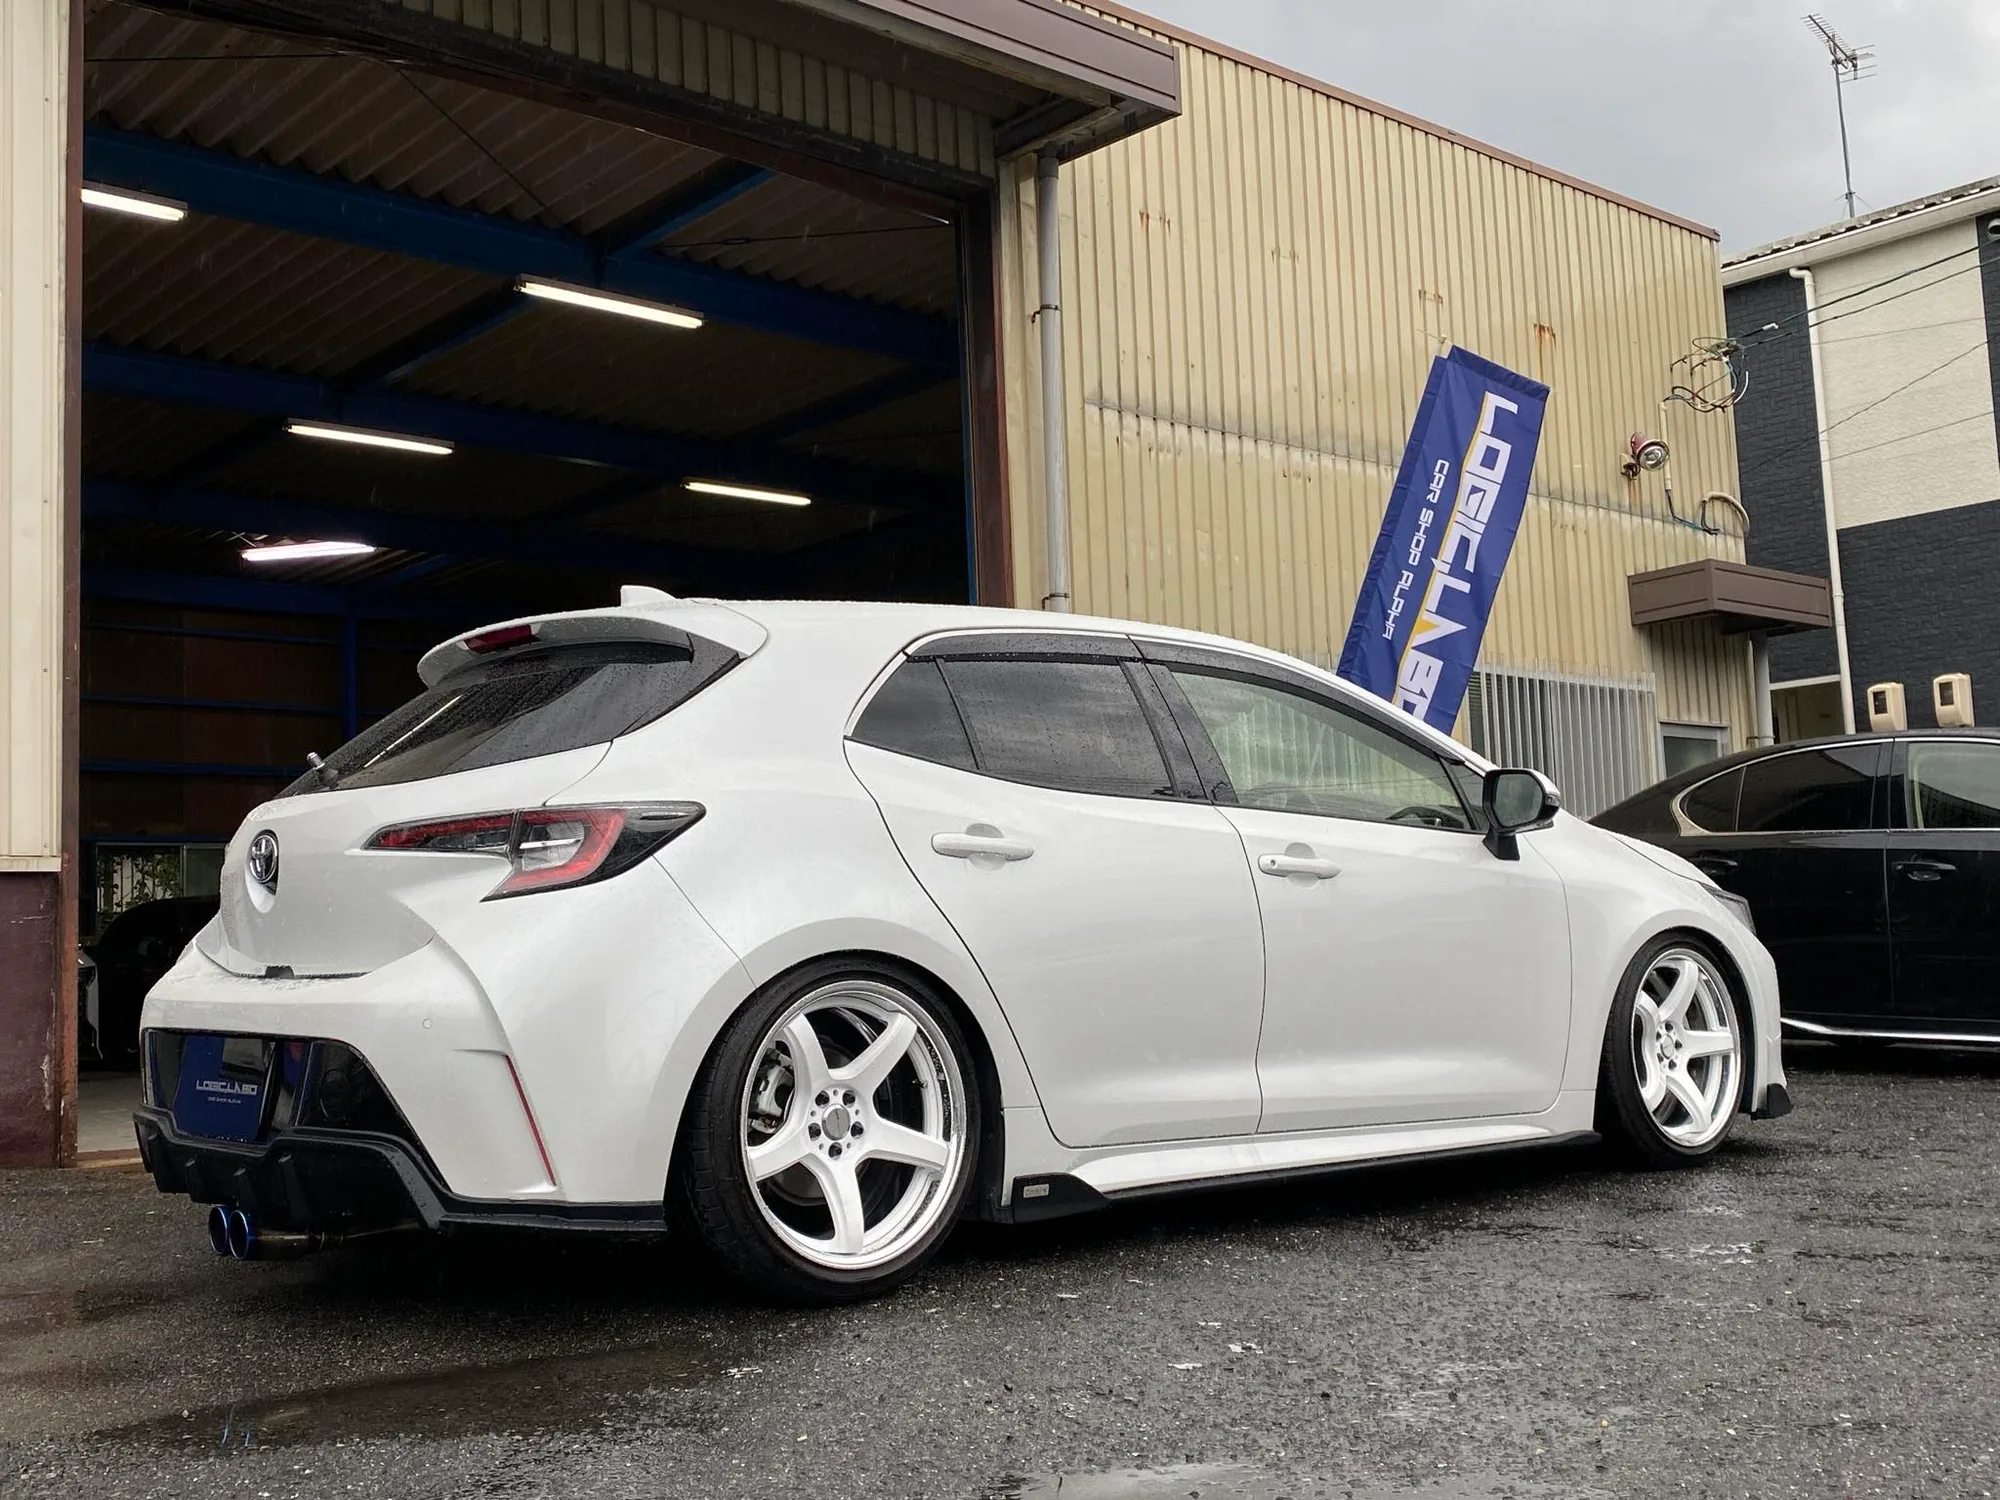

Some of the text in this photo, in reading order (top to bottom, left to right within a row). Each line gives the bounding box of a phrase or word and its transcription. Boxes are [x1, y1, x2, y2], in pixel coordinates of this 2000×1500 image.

[1382, 459, 1450, 640] CAR SHOP ALPHA
